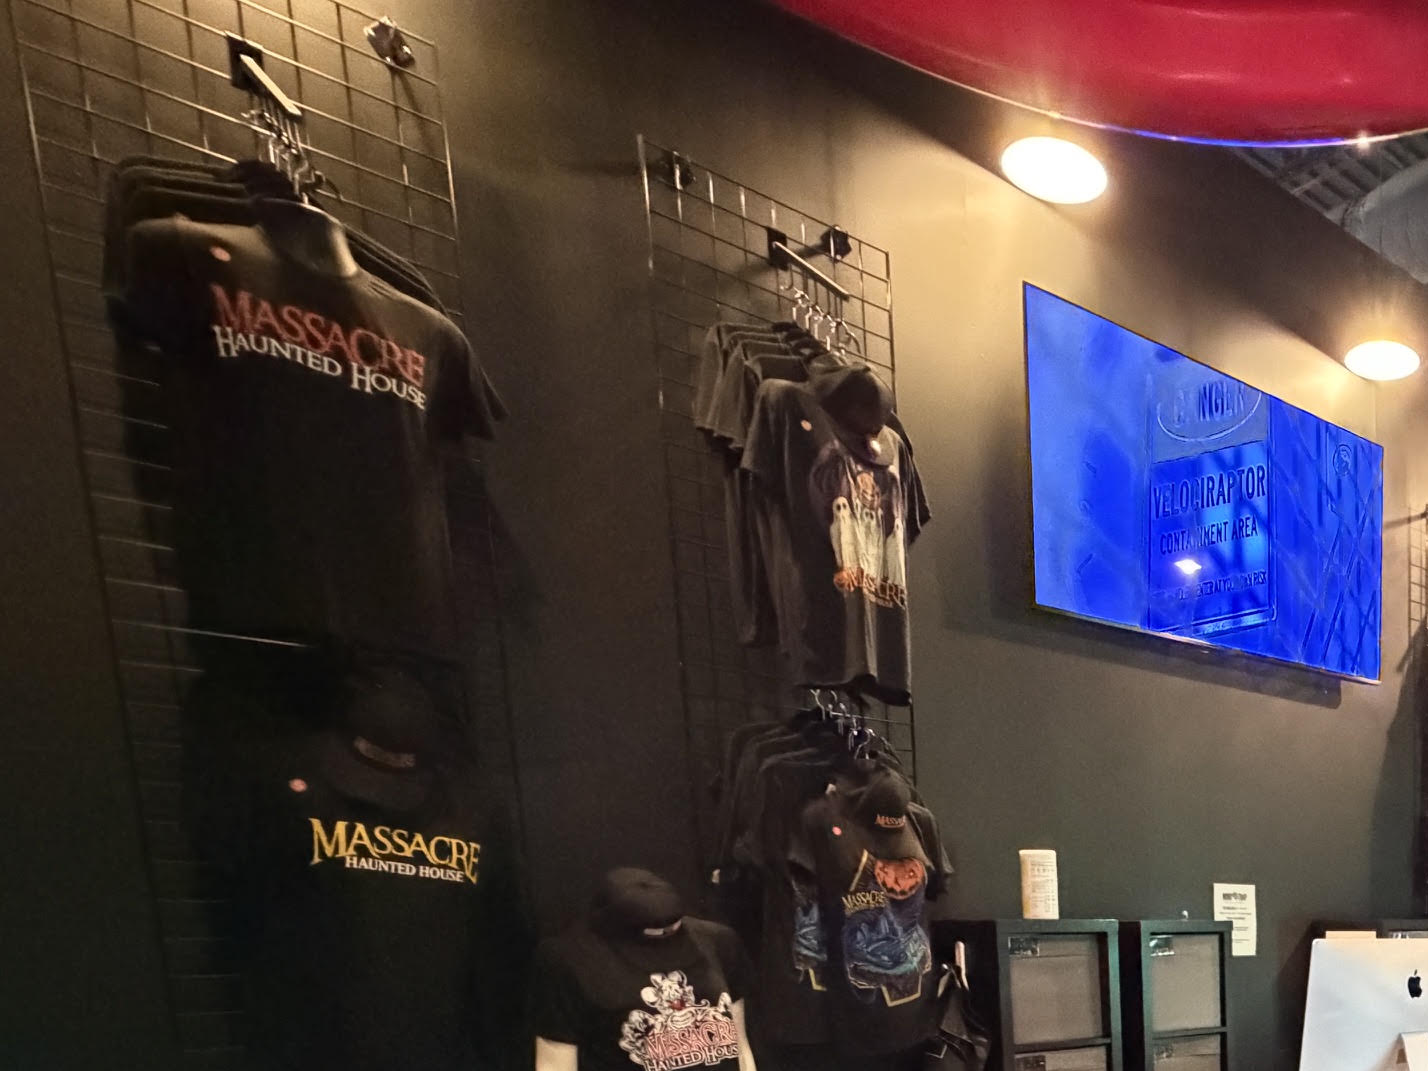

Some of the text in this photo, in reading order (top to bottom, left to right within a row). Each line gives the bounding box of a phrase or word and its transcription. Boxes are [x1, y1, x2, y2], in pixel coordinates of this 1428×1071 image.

[210, 283, 426, 387] MASSACRE
[212, 326, 427, 410] HAUNTED HOUSE
[1154, 464, 1266, 519] VELOCIRAPTOR
[1231, 514, 1258, 541] AREA
[309, 817, 481, 884] MASSACRE
[344, 855, 464, 883] HAUNTED HOUSE
[646, 1020, 738, 1062] MSSACR
[704, 1043, 738, 1064] HOUS
